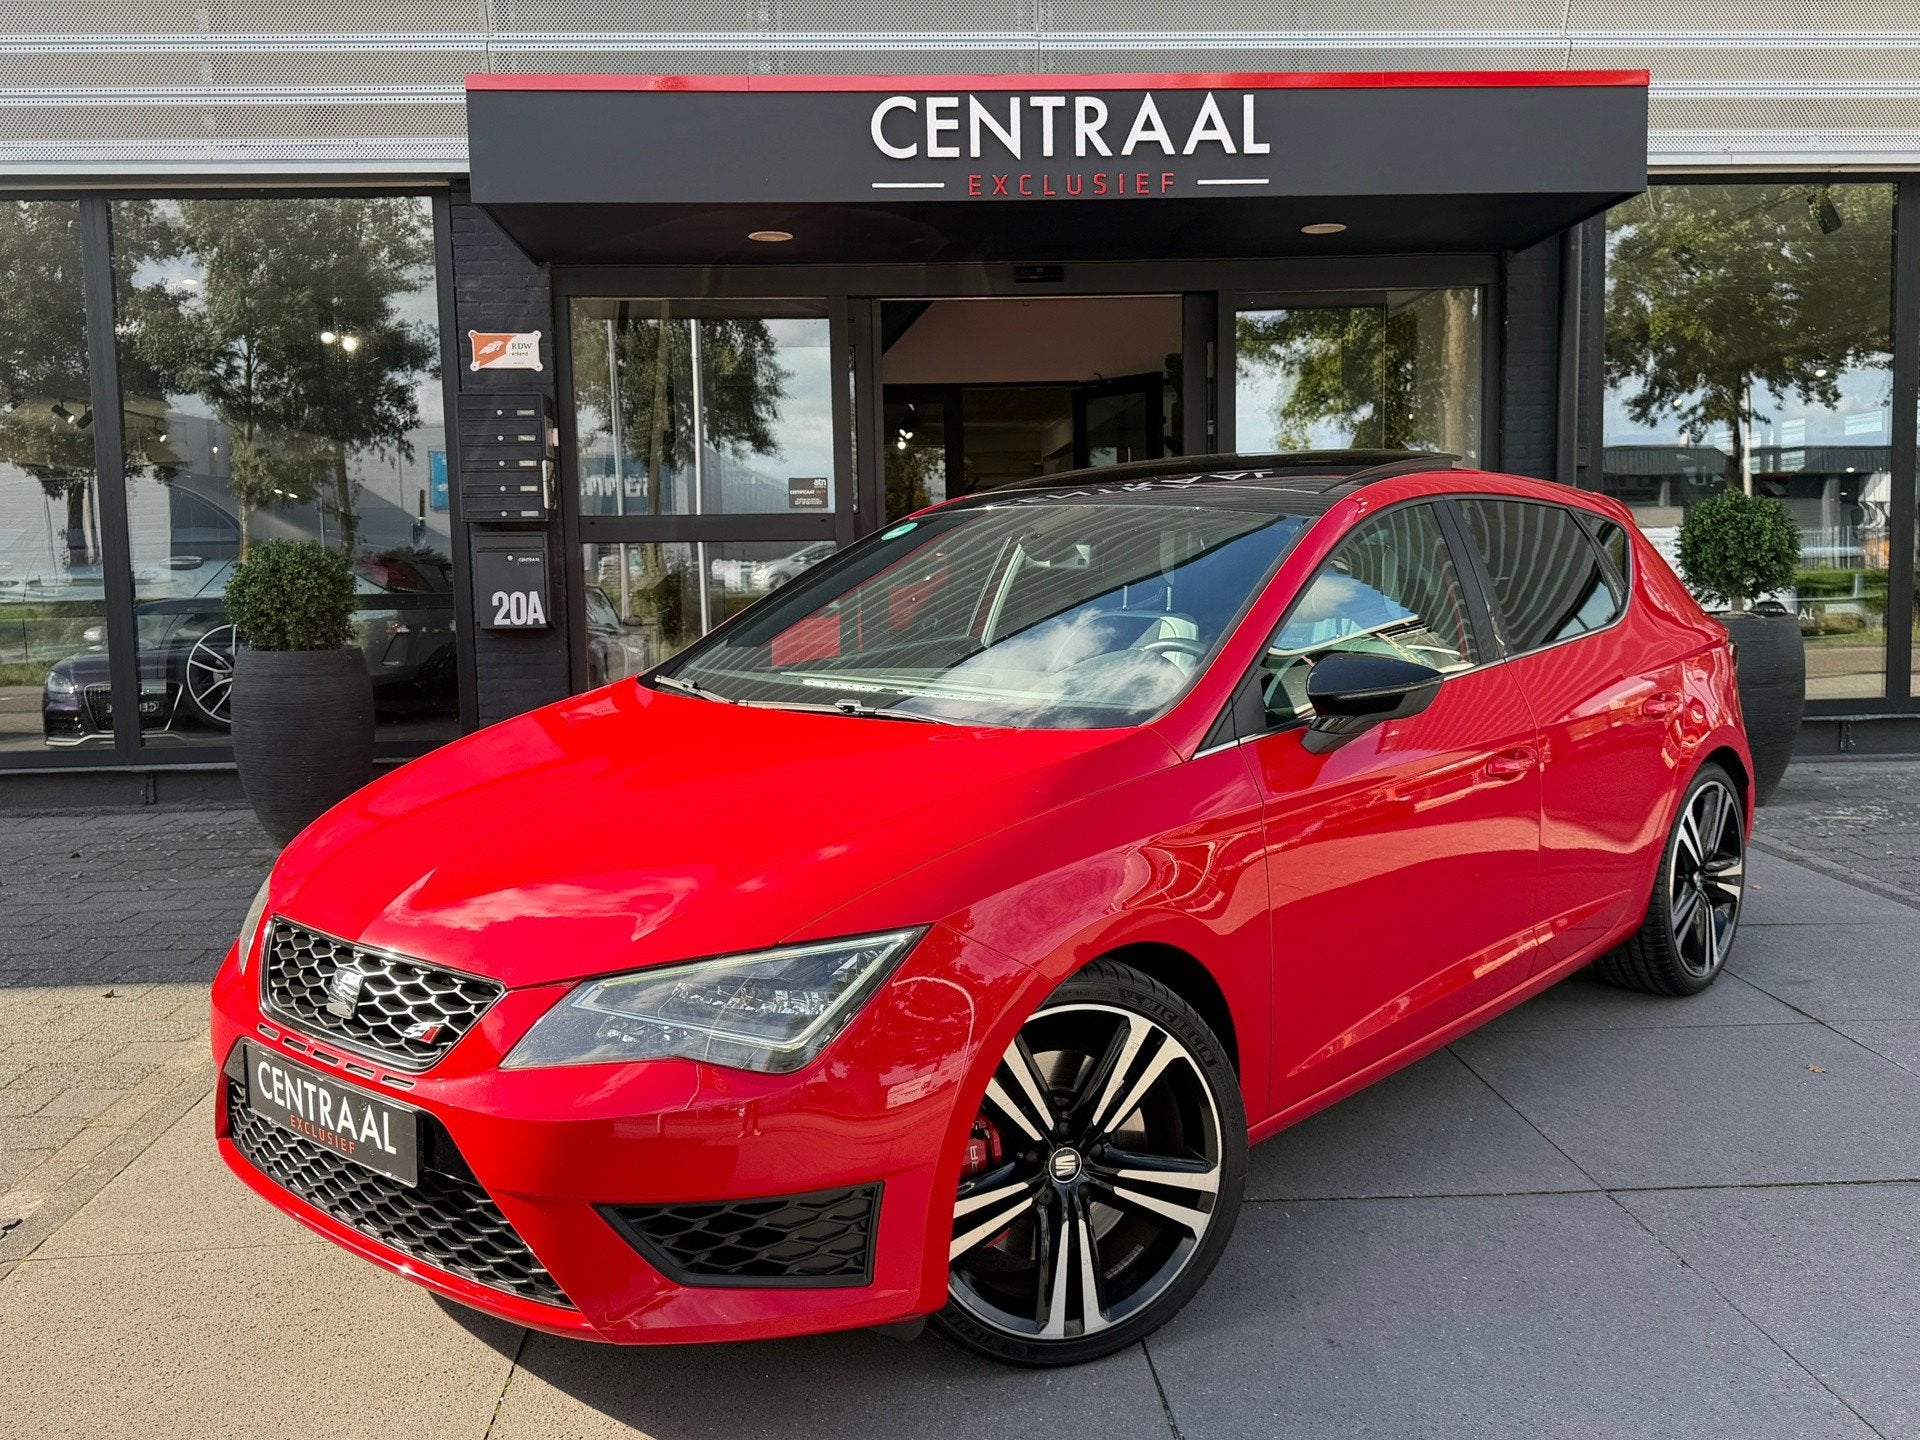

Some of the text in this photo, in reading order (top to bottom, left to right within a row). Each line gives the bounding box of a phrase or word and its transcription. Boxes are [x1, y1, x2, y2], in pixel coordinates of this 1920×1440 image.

[871, 91, 1270, 160] CENTRAAL
[968, 172, 1175, 197] EXCLUSIEF
[511, 342, 532, 350] RDW
[491, 590, 547, 626] 20A
[1140, 998, 1217, 1068] MICHELIN
[257, 1060, 397, 1155] CENTRAAL
[289, 1114, 356, 1154] EXCLUSIEF
